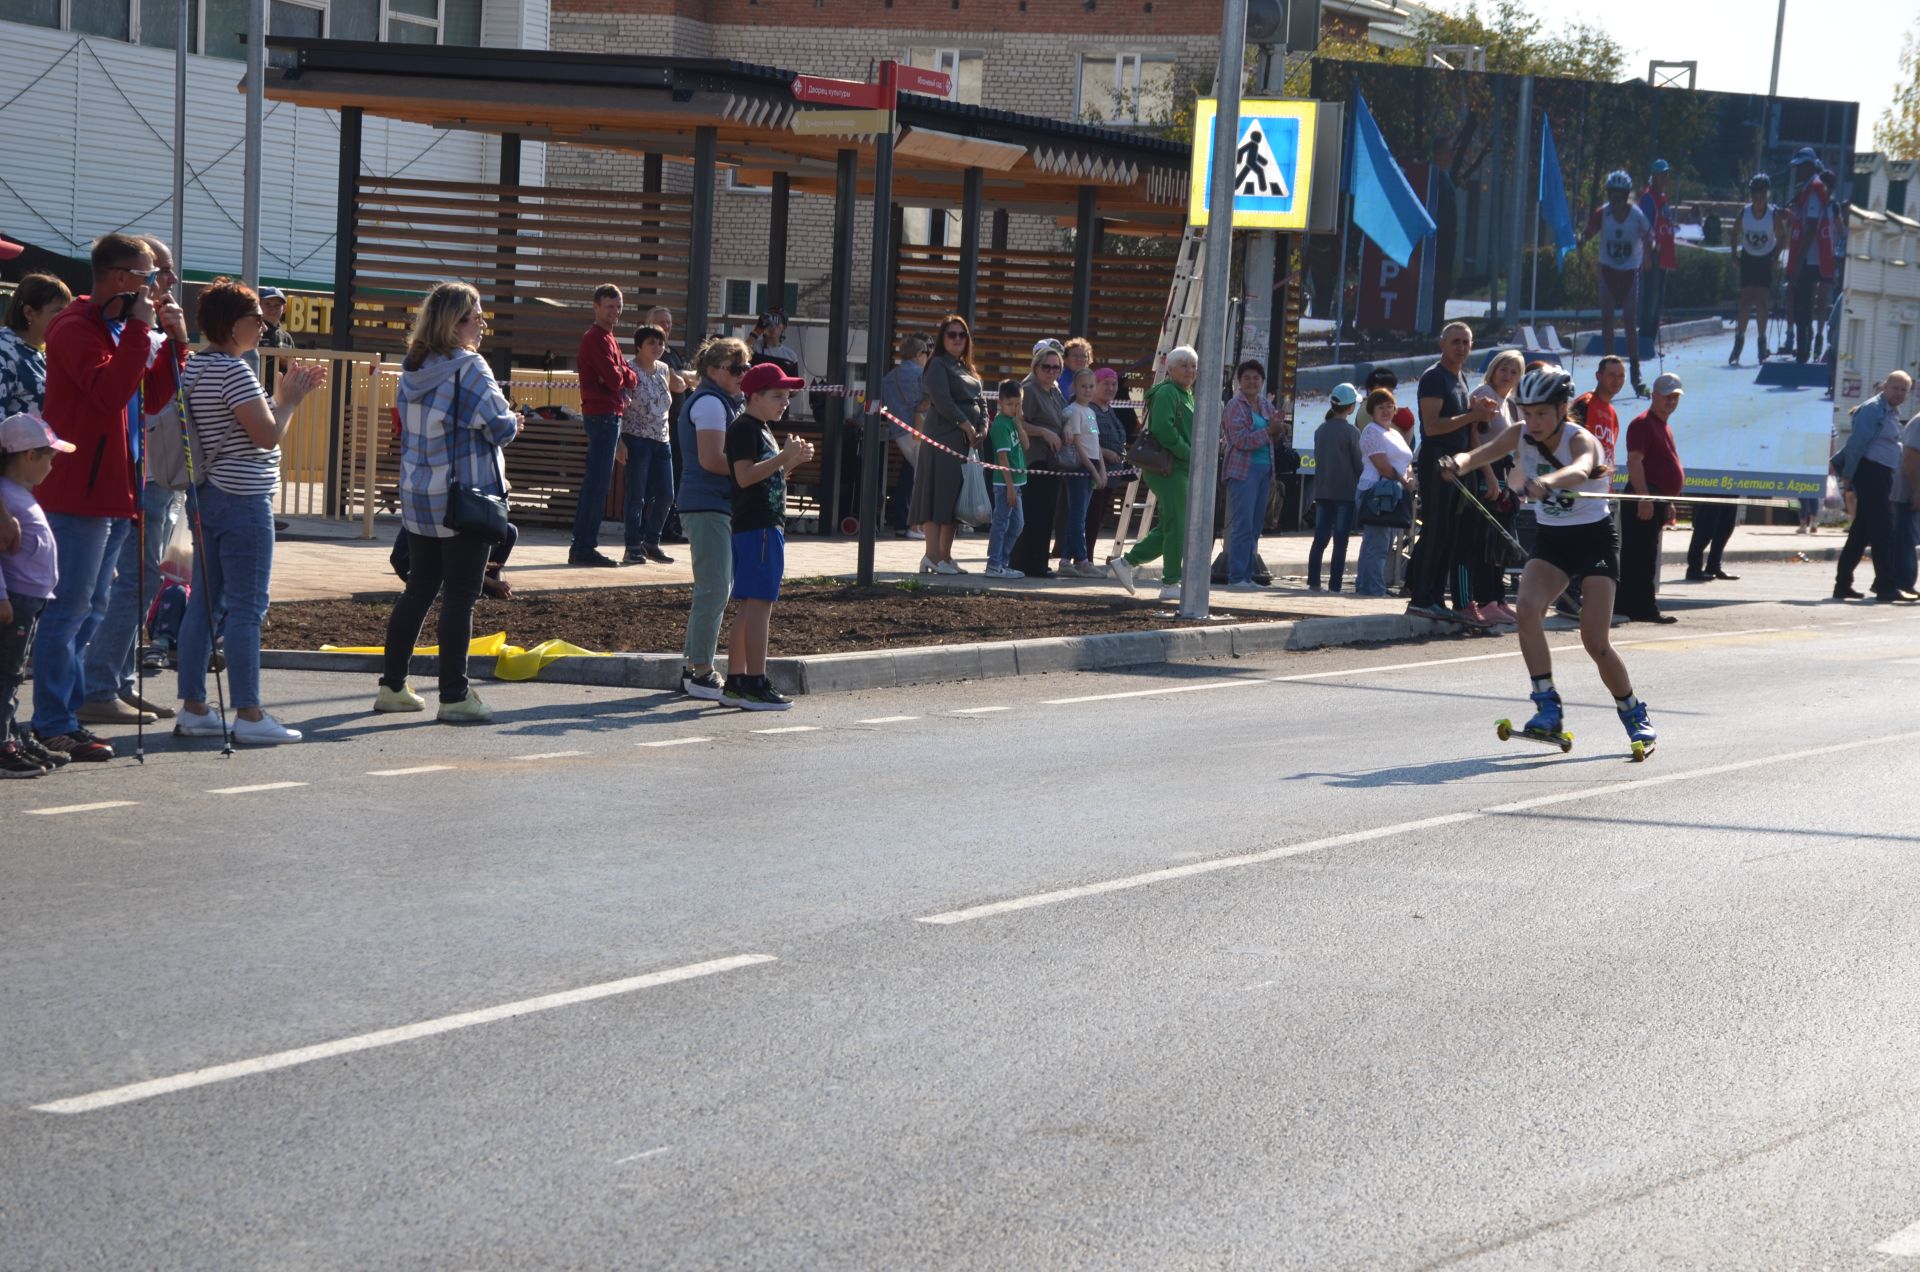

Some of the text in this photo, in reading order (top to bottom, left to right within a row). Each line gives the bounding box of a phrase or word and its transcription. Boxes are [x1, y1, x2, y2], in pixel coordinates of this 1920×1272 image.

[808, 84, 851, 98] Дворец культуры
[1379, 258, 1400, 320] РТ
[1721, 476, 1776, 490] 85-летию
[1786, 479, 1820, 494] Агрыз
